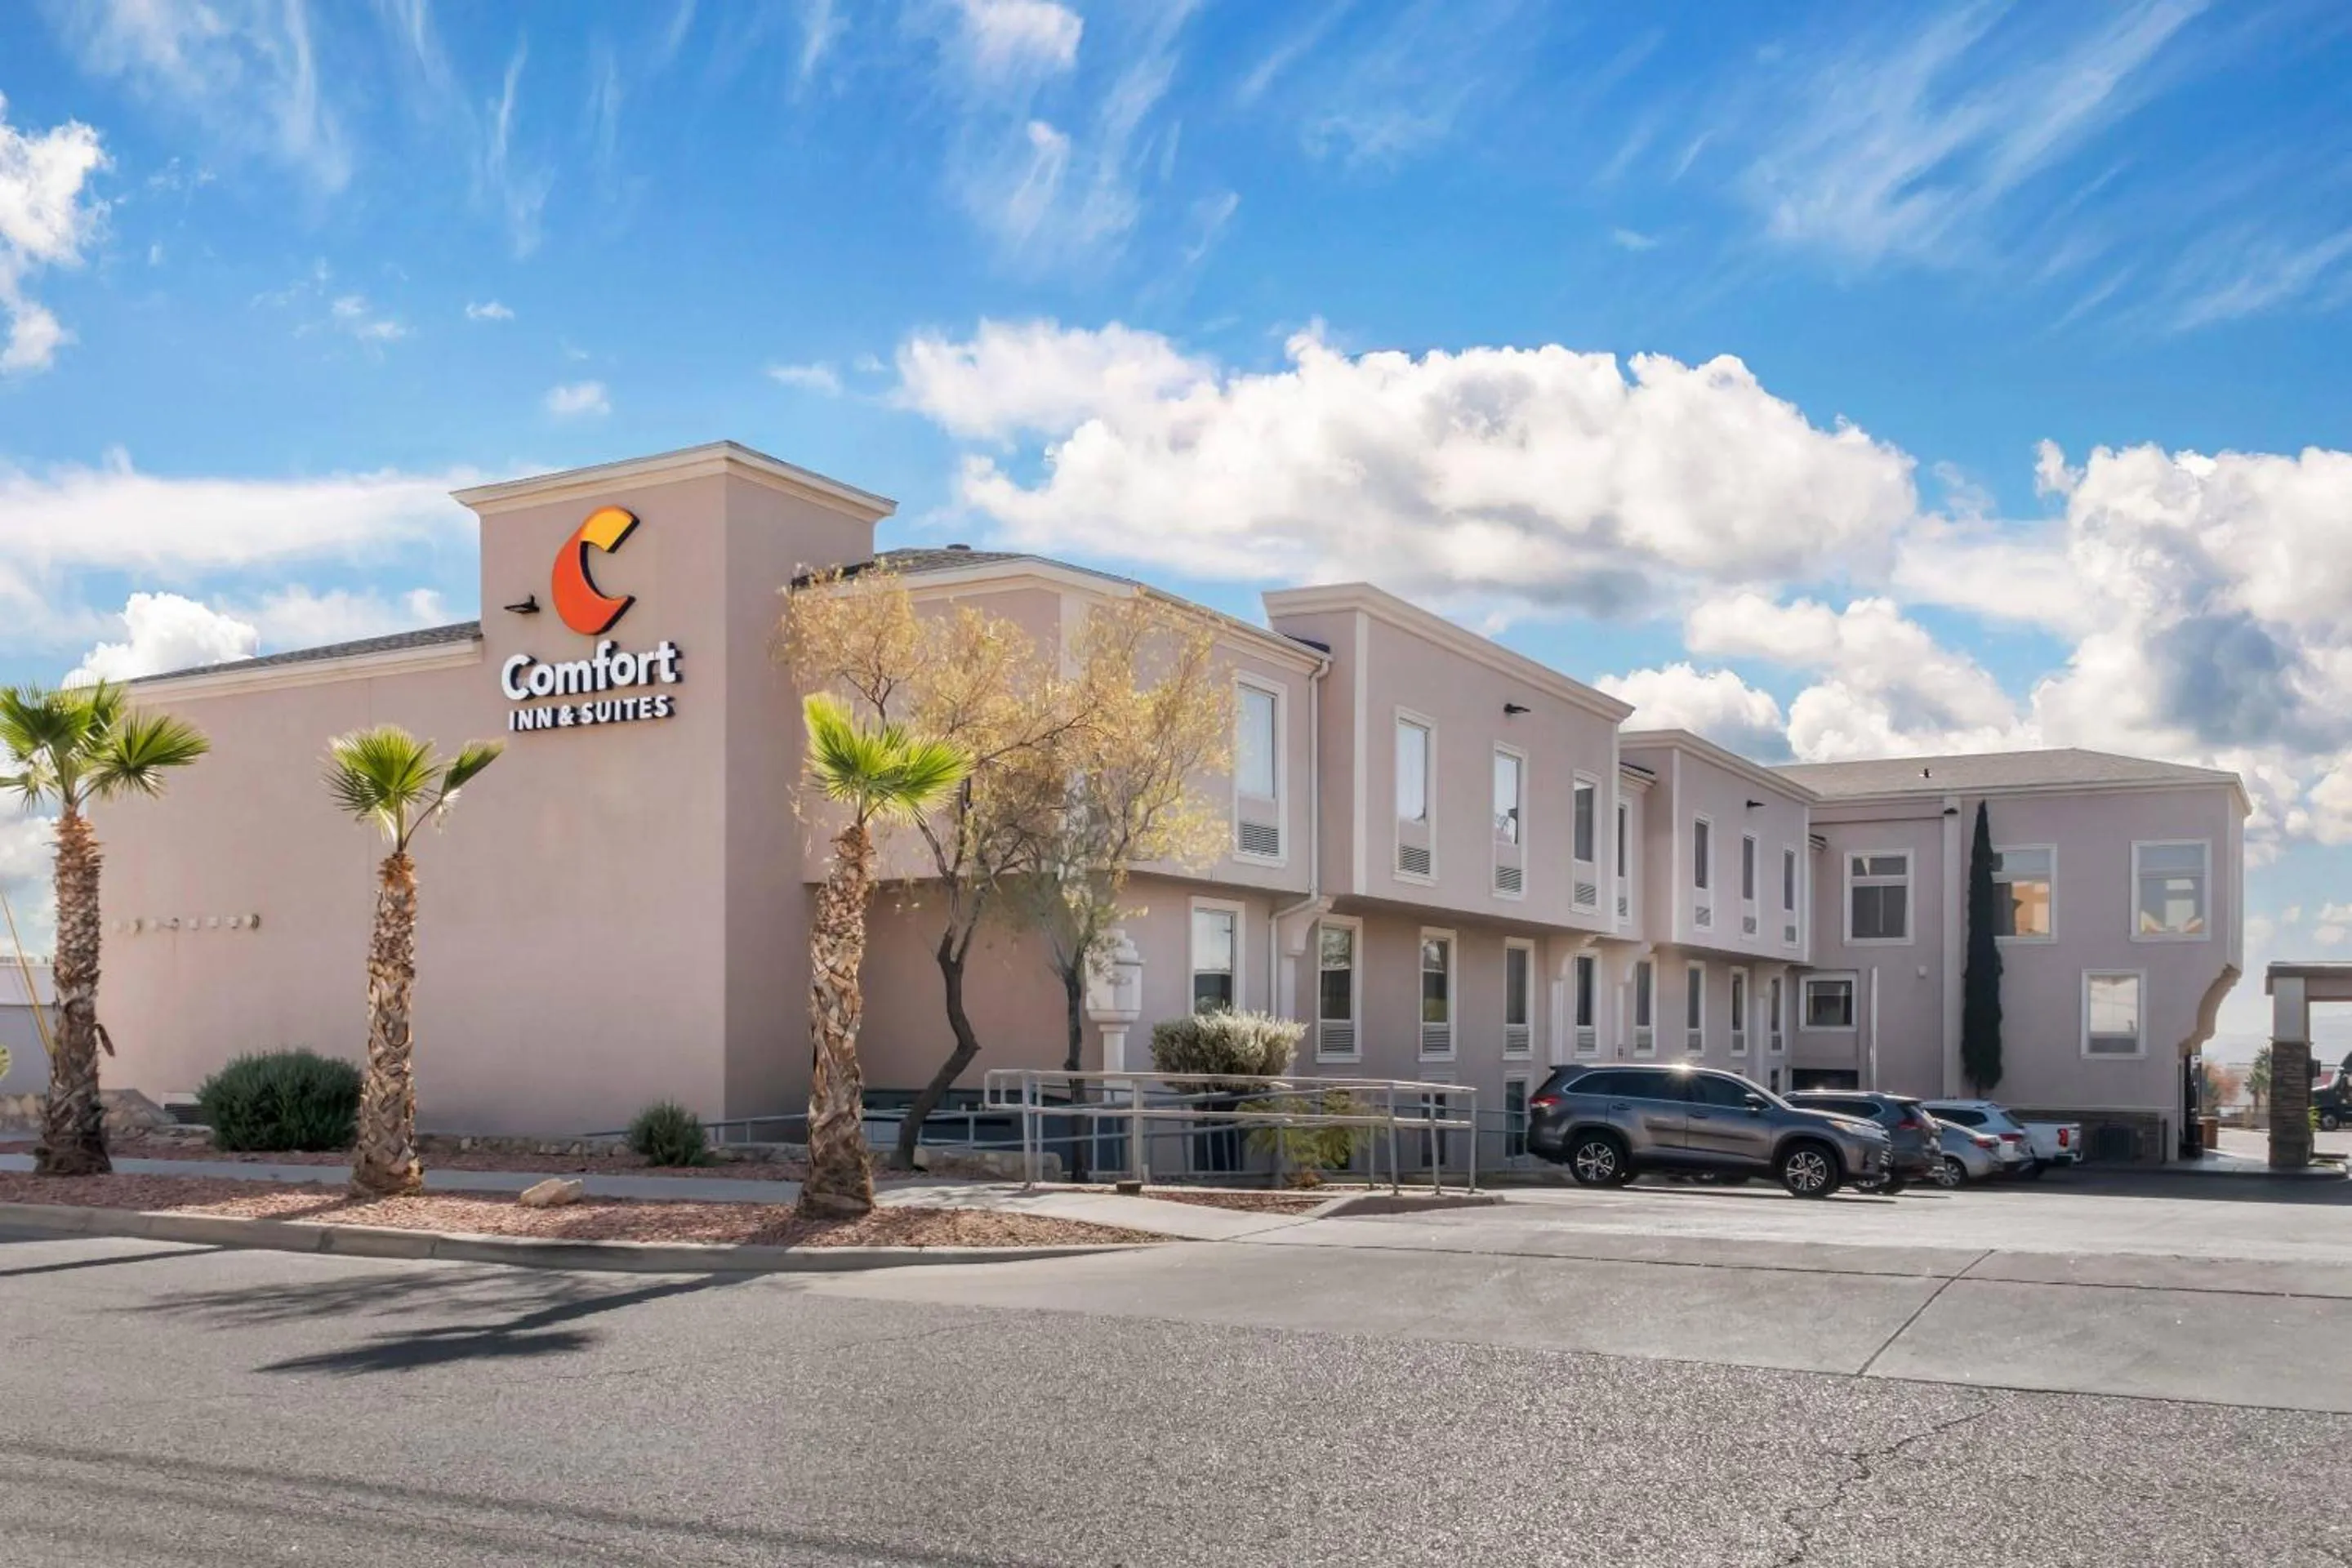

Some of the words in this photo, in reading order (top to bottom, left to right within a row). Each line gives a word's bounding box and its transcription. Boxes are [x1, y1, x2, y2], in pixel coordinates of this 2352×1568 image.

[501, 639, 679, 702] Comfort
[508, 705, 555, 732] INN
[557, 704, 575, 728] &
[580, 695, 672, 724] SUITES
